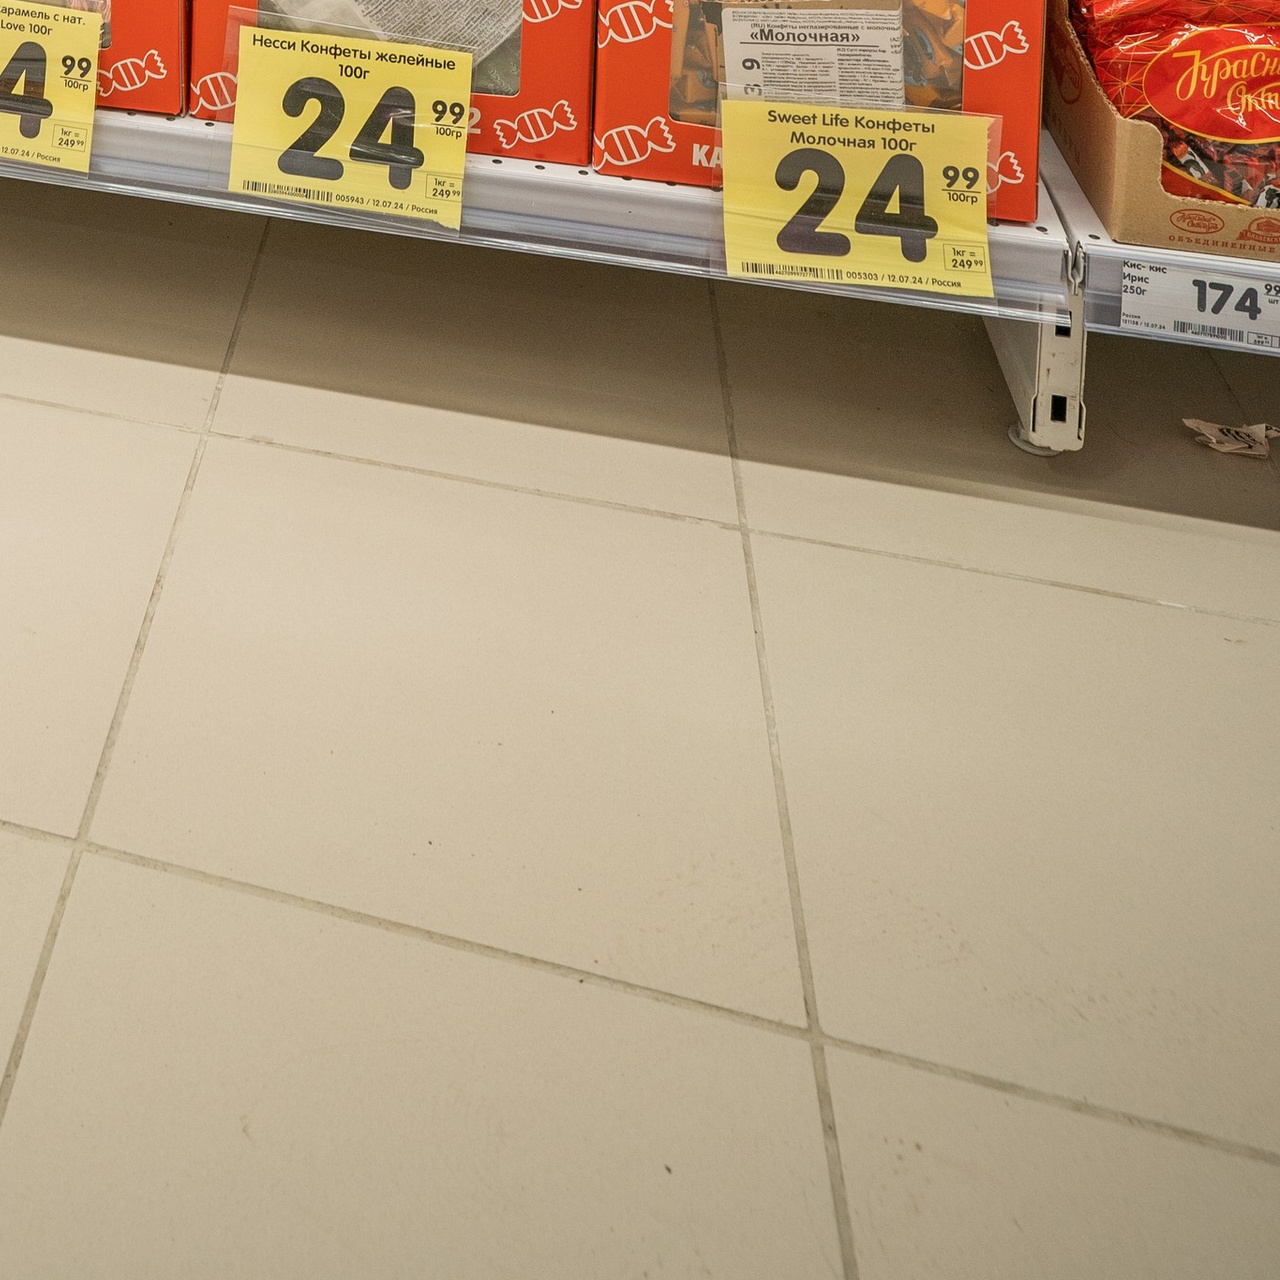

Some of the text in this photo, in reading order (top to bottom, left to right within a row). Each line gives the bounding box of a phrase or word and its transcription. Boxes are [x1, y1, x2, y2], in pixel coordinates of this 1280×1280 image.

[1, 19, 26, 32] Love
[29, 24, 52, 36] 100г
[54, 14, 59, 22] с
[63, 15, 85, 25] нат.
[750, 28, 860, 43] «Молочная»
[253, 34, 456, 70] Несси Конфеты желейные
[338, 64, 370, 79] 100г
[768, 110, 935, 133] Sweet Life Конфеты
[278, 77, 464, 190] 24 99
[790, 131, 917, 152] Молочная 100г
[775, 148, 938, 263] 24
[947, 192, 978, 205] 100гр
[1123, 260, 1167, 274] Кис- кис
[1123, 272, 1149, 285] Ирис
[1123, 285, 1146, 296] 250г
[1193, 279, 1262, 320] 174
